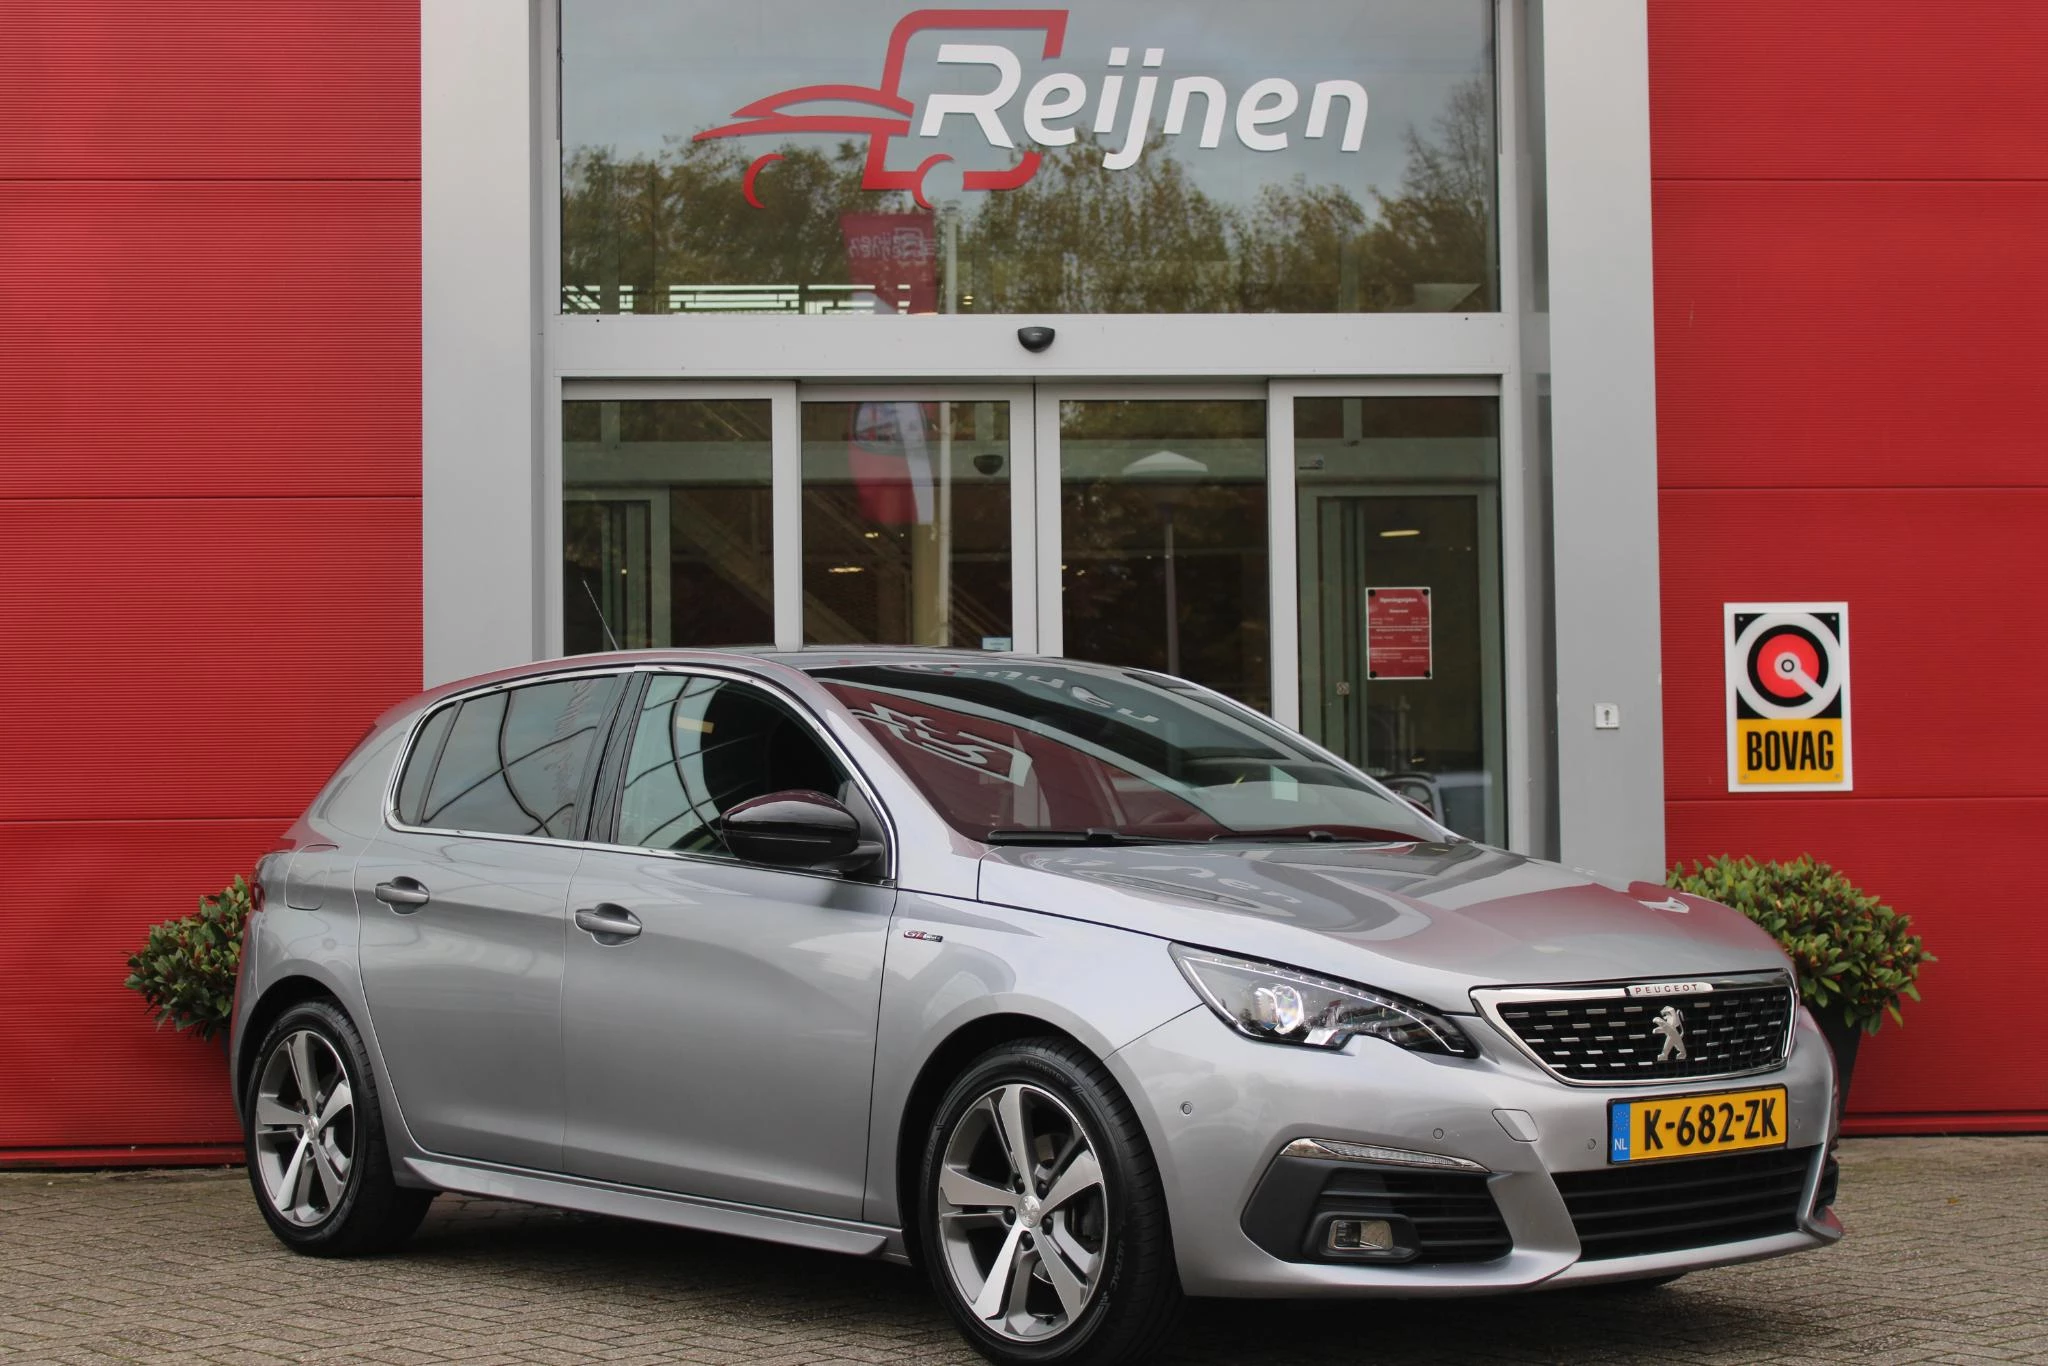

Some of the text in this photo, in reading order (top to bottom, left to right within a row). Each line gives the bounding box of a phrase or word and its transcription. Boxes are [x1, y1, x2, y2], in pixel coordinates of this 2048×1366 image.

[919, 43, 1369, 170] Reijnen
[1746, 729, 1834, 772] BOVAG
[1634, 983, 1699, 995] PEUGEOT
[1613, 1137, 1628, 1151] NL
[1643, 1096, 1779, 1152] K-682-ZK
